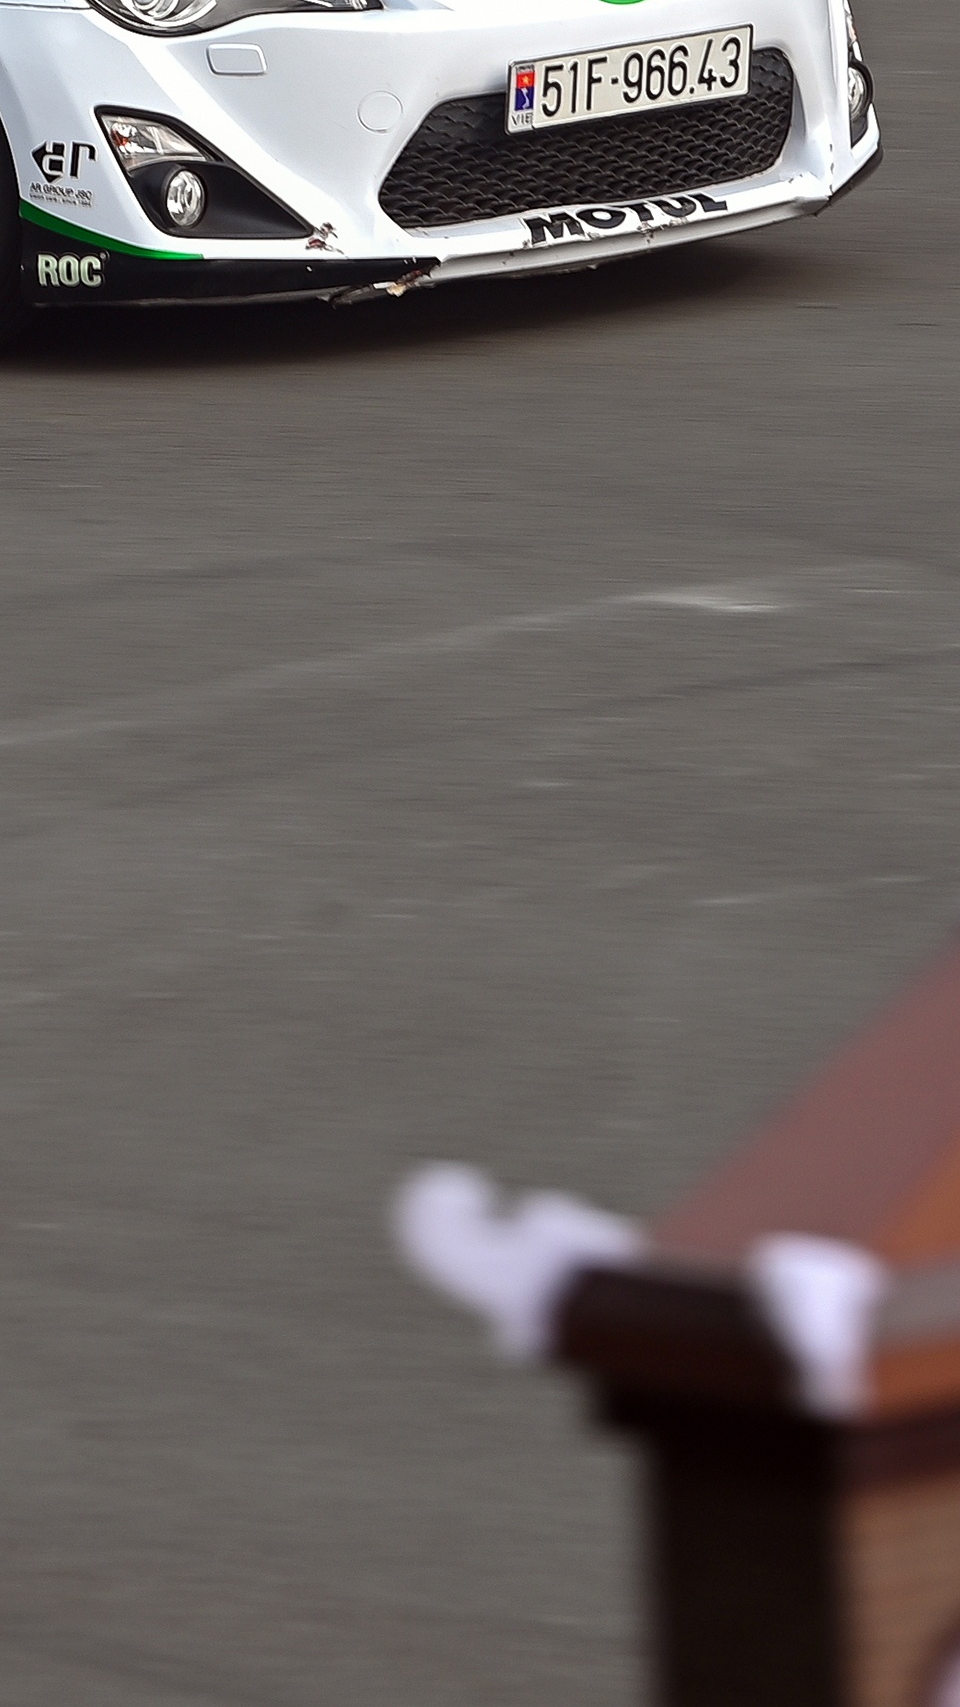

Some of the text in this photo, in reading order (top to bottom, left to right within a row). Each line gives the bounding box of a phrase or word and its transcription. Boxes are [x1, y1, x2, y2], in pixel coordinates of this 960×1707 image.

[542, 37, 740, 117] 51F-966.43
[524, 194, 727, 244] MOTUL
[37, 253, 102, 287] ROC
